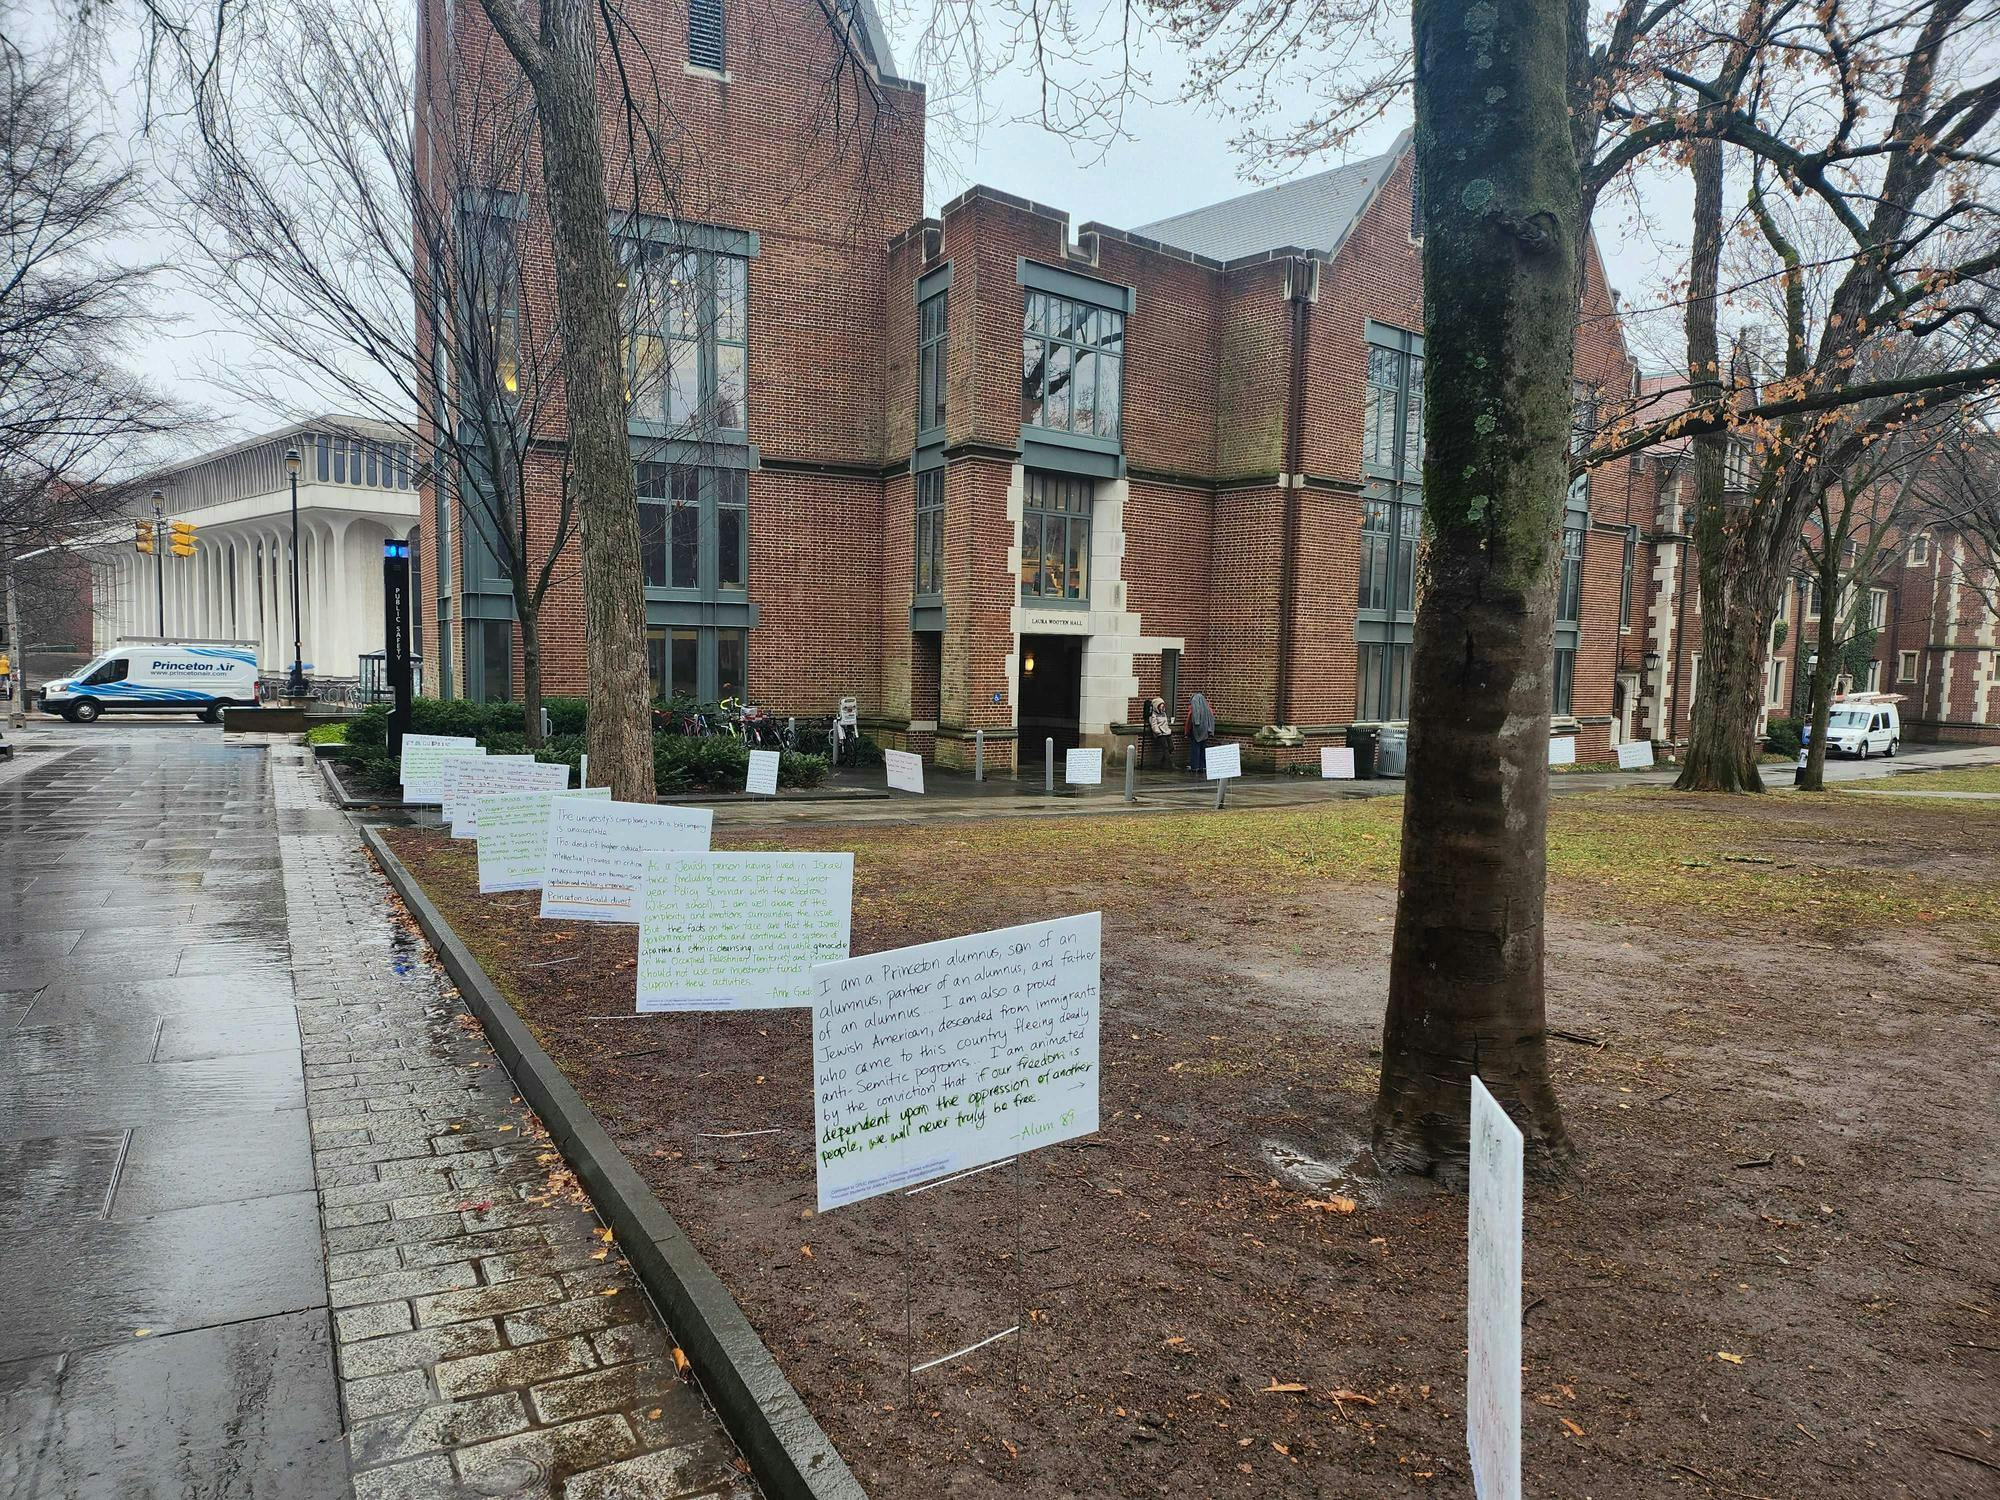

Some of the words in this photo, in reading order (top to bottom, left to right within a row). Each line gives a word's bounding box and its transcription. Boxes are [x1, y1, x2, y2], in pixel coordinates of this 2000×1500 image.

[152, 660, 214, 671] Princeton
[216, 662, 235, 671] Air
[648, 860, 657, 871] As
[675, 859, 707, 872] Jewish
[713, 862, 740, 875] person
[745, 859, 771, 875] having
[776, 860, 794, 869] lived
[798, 862, 806, 870] in
[812, 859, 843, 870] Israel
[756, 874, 773, 885] part
[777, 873, 784, 881] of
[787, 876, 800, 887] my
[802, 876, 829, 885] junior
[547, 891, 582, 901] Princeton
[646, 889, 666, 899] year
[673, 884, 699, 900] Policy
[707, 887, 744, 896] Seminar
[750, 887, 768, 895] with
[770, 887, 787, 895] the
[721, 900, 728, 908] I
[751, 898, 767, 907] well
[800, 899, 808, 907] of
[812, 898, 827, 906] the
[690, 910, 705, 919] and
[709, 911, 742, 919] emotions
[748, 910, 792, 921] surrounding
[644, 924, 660, 935] But
[667, 924, 683, 933] the
[687, 923, 706, 933] facts
[784, 921, 799, 929] that
[643, 933, 692, 945] government
[699, 934, 727, 943] supports
[751, 931, 786, 940] continues
[802, 932, 827, 942] system
[831, 930, 838, 939] of
[688, 943, 714, 954] ethnic
[758, 943, 774, 951] and
[813, 939, 847, 955] genocide
[671, 955, 705, 967] Occupied
[818, 977, 831, 997] I
[840, 976, 861, 992] am
[865, 974, 873, 984] a
[882, 957, 940, 983] Princeton
[946, 948, 1002, 966] alumnus,
[1008, 942, 1032, 957] son
[1039, 930, 1054, 948] of
[1059, 932, 1077, 945] an
[640, 968, 672, 979] should
[676, 968, 688, 977] not
[730, 965, 774, 974] investment
[777, 964, 802, 974] funds
[642, 981, 679, 992] support
[819, 995, 882, 1019] alumnus,
[886, 982, 932, 1009] partner
[937, 973, 951, 990] of
[953, 973, 971, 987] an
[974, 964, 1026, 981] alumnus,
[1032, 956, 1054, 972] and
[1061, 950, 1096, 965] father
[818, 1020, 832, 1042] of
[841, 1021, 858, 1035] an
[942, 994, 952, 1010] I
[958, 993, 977, 1006] am
[980, 986, 1008, 999] also
[1013, 985, 1020, 994] a
[1027, 974, 1056, 998] proud
[817, 1041, 863, 1064] Jewish
[871, 1025, 934, 1049] American,
[938, 1009, 993, 1033] descended
[1000, 1003, 1029, 1019] from
[1036, 984, 1097, 1011] immigrants
[819, 1067, 847, 1086] who
[855, 1056, 893, 1076] came
[900, 1048, 913, 1062] to
[920, 1043, 946, 1059] this
[956, 1027, 1008, 1051] country
[1015, 1016, 1054, 1036] fleeing
[1059, 1007, 1090, 1027] deadly
[990, 1046, 1001, 1059] I
[1006, 1045, 1024, 1057] am
[1031, 1027, 1084, 1050] animated
[823, 1107, 840, 1126] by
[846, 1101, 868, 1115] the
[876, 1084, 935, 1107] conviction
[942, 1073, 967, 1092] that
[976, 1066, 991, 1084] if
[991, 1066, 1012, 1079] our
[1016, 1050, 1066, 1072] freedom
[1069, 1046, 1080, 1057] is
[822, 1107, 891, 1144] dependent
[900, 1104, 929, 1126] upon
[936, 1095, 960, 1112] the
[968, 1078, 1029, 1108] oppression
[1037, 1071, 1051, 1085] of
[1052, 1061, 1094, 1080] another
[820, 1140, 863, 1169] people,
[868, 1133, 887, 1149] we
[890, 1124, 910, 1143] will
[919, 1117, 950, 1134] never
[955, 1108, 986, 1131] truly
[993, 1101, 1008, 1113] be
[1013, 1092, 1040, 1108] free.
